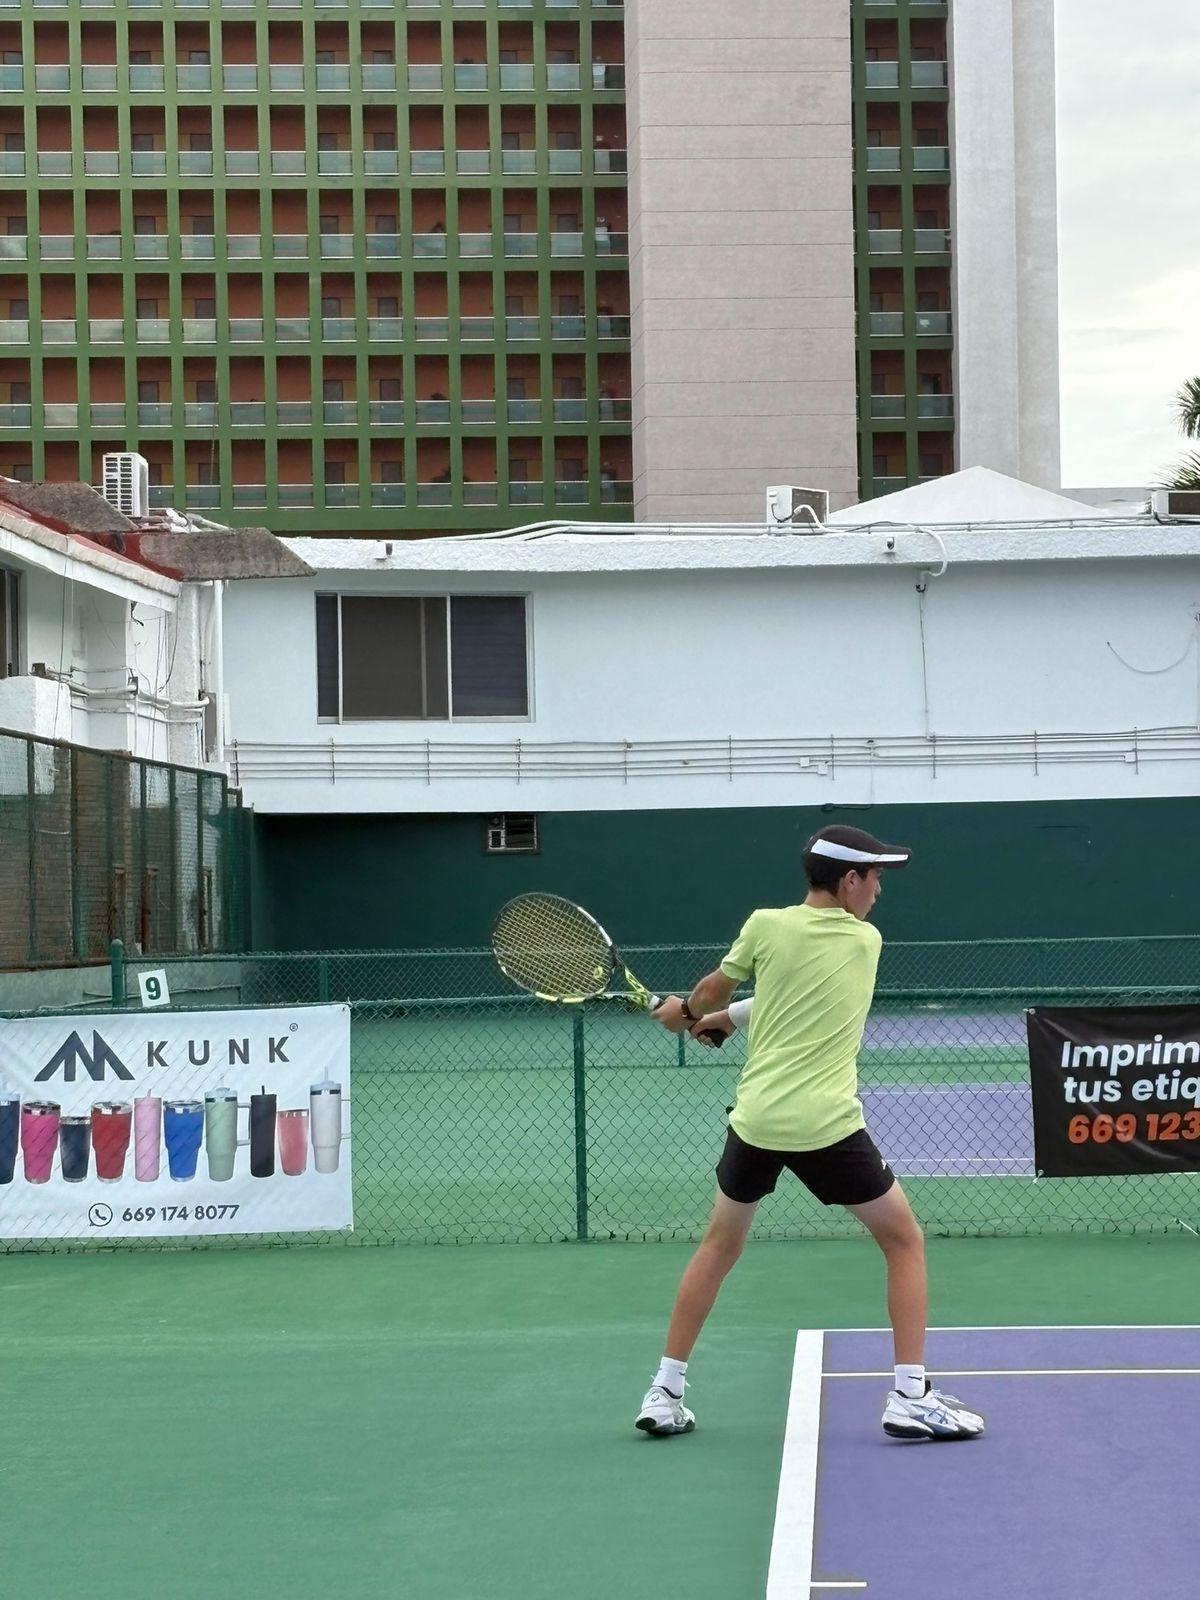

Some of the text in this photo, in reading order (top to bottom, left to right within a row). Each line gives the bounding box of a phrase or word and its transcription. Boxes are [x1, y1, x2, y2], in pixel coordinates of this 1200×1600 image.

[145, 976, 162, 1001] 9
[147, 1036, 290, 1067] KUNK
[1061, 1034, 1200, 1076] Imprim
[1064, 1069, 1200, 1109] tus etiq
[1068, 1110, 1200, 1144] 669 123
[122, 1204, 240, 1222] 669 174 8077
